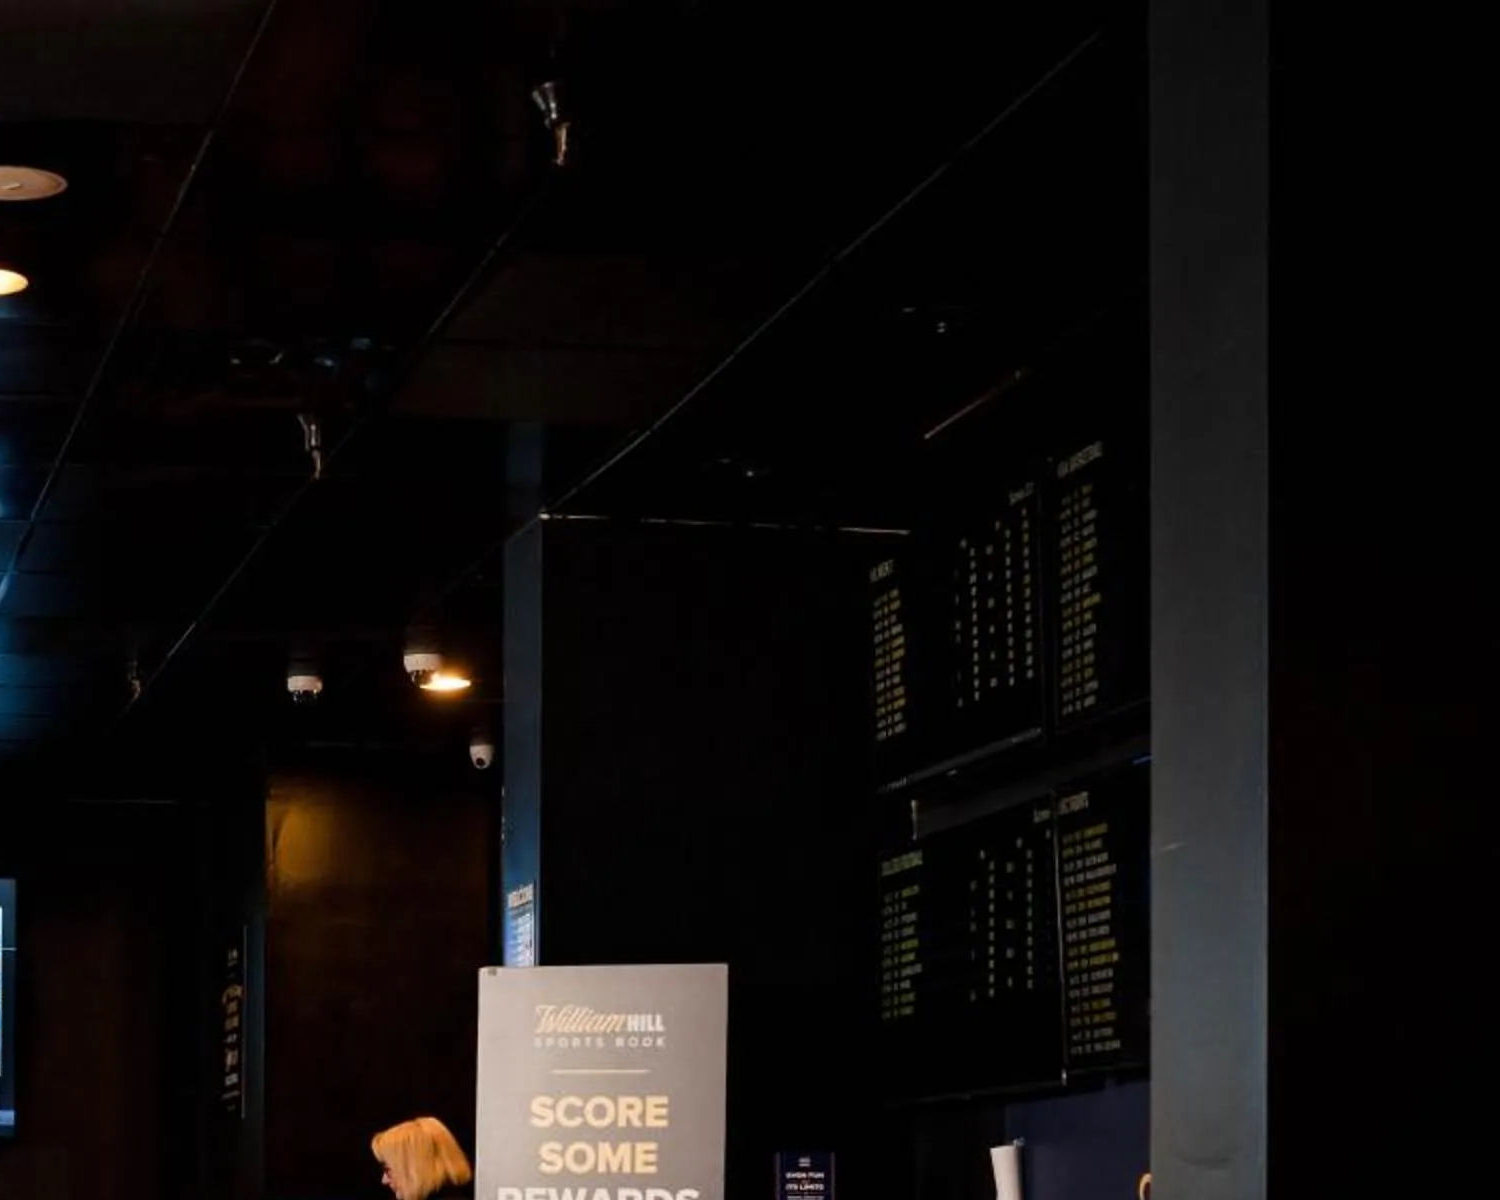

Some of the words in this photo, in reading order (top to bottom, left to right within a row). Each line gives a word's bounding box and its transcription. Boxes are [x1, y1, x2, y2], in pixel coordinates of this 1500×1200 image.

[534, 1004, 625, 1033] William
[626, 1014, 665, 1031] HILL
[534, 1036, 606, 1048] SPORTS
[615, 1036, 666, 1048] BOOK
[530, 1095, 669, 1128] SCORE
[538, 1141, 659, 1174] SOME
